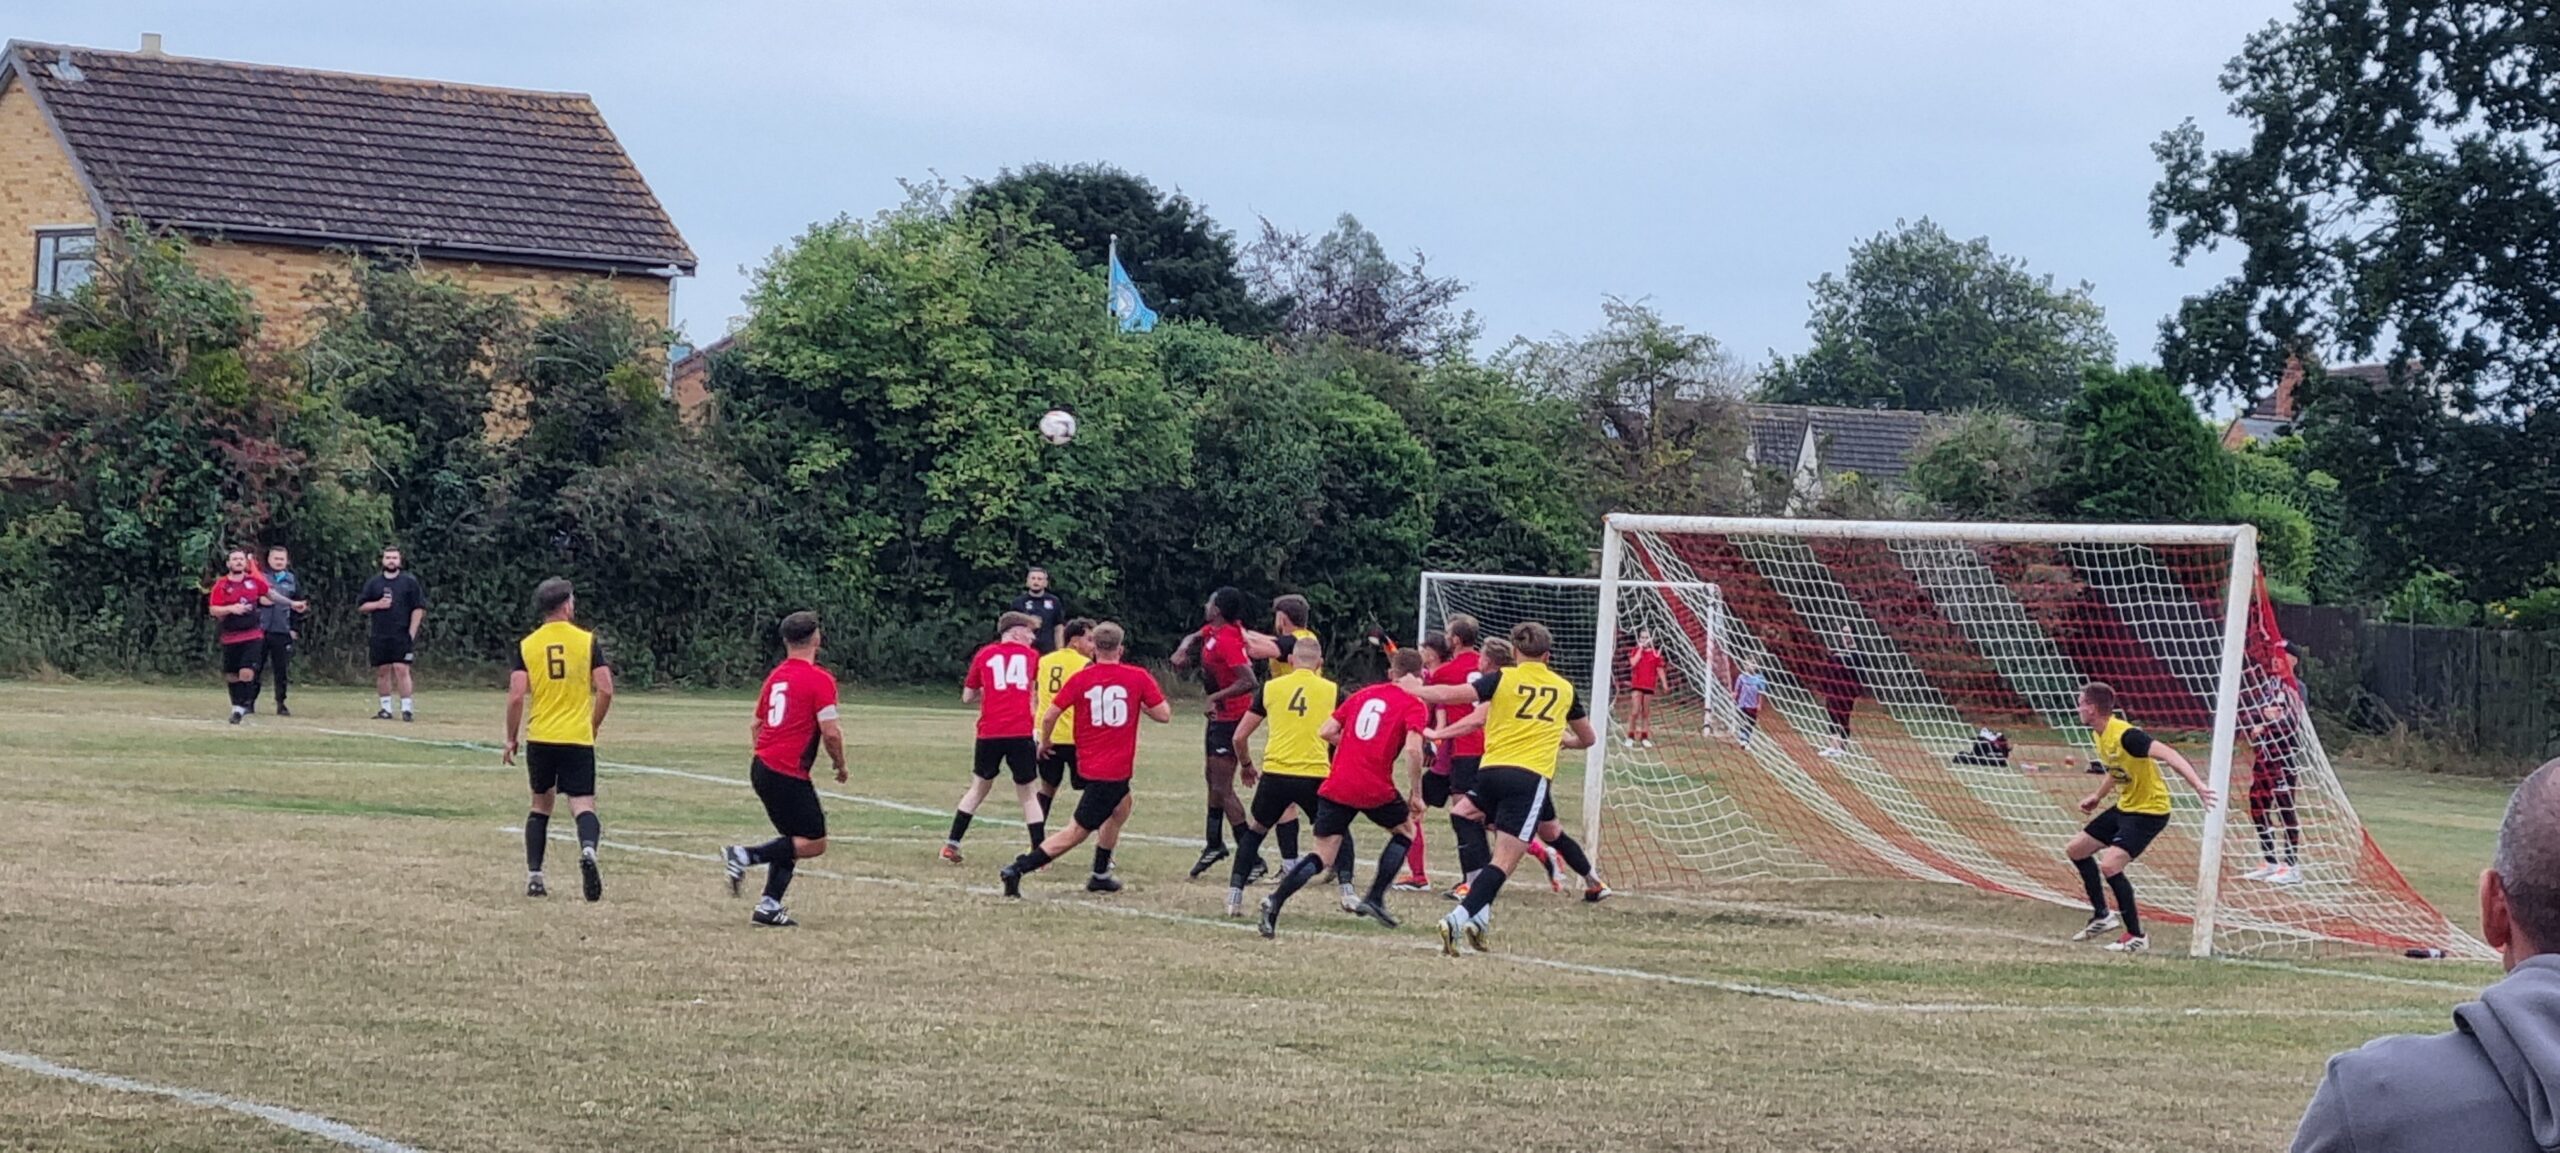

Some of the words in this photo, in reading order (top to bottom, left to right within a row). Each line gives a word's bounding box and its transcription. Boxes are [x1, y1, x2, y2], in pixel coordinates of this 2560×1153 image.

[546, 644, 565, 679] 6
[986, 654, 1029, 691] 14
[1049, 666, 1063, 693] 8
[767, 682, 789, 728] 5
[1084, 685, 1129, 728] 16
[1288, 687, 1307, 717] 4
[1355, 698, 1386, 740] 6
[1515, 685, 1558, 722] 22
